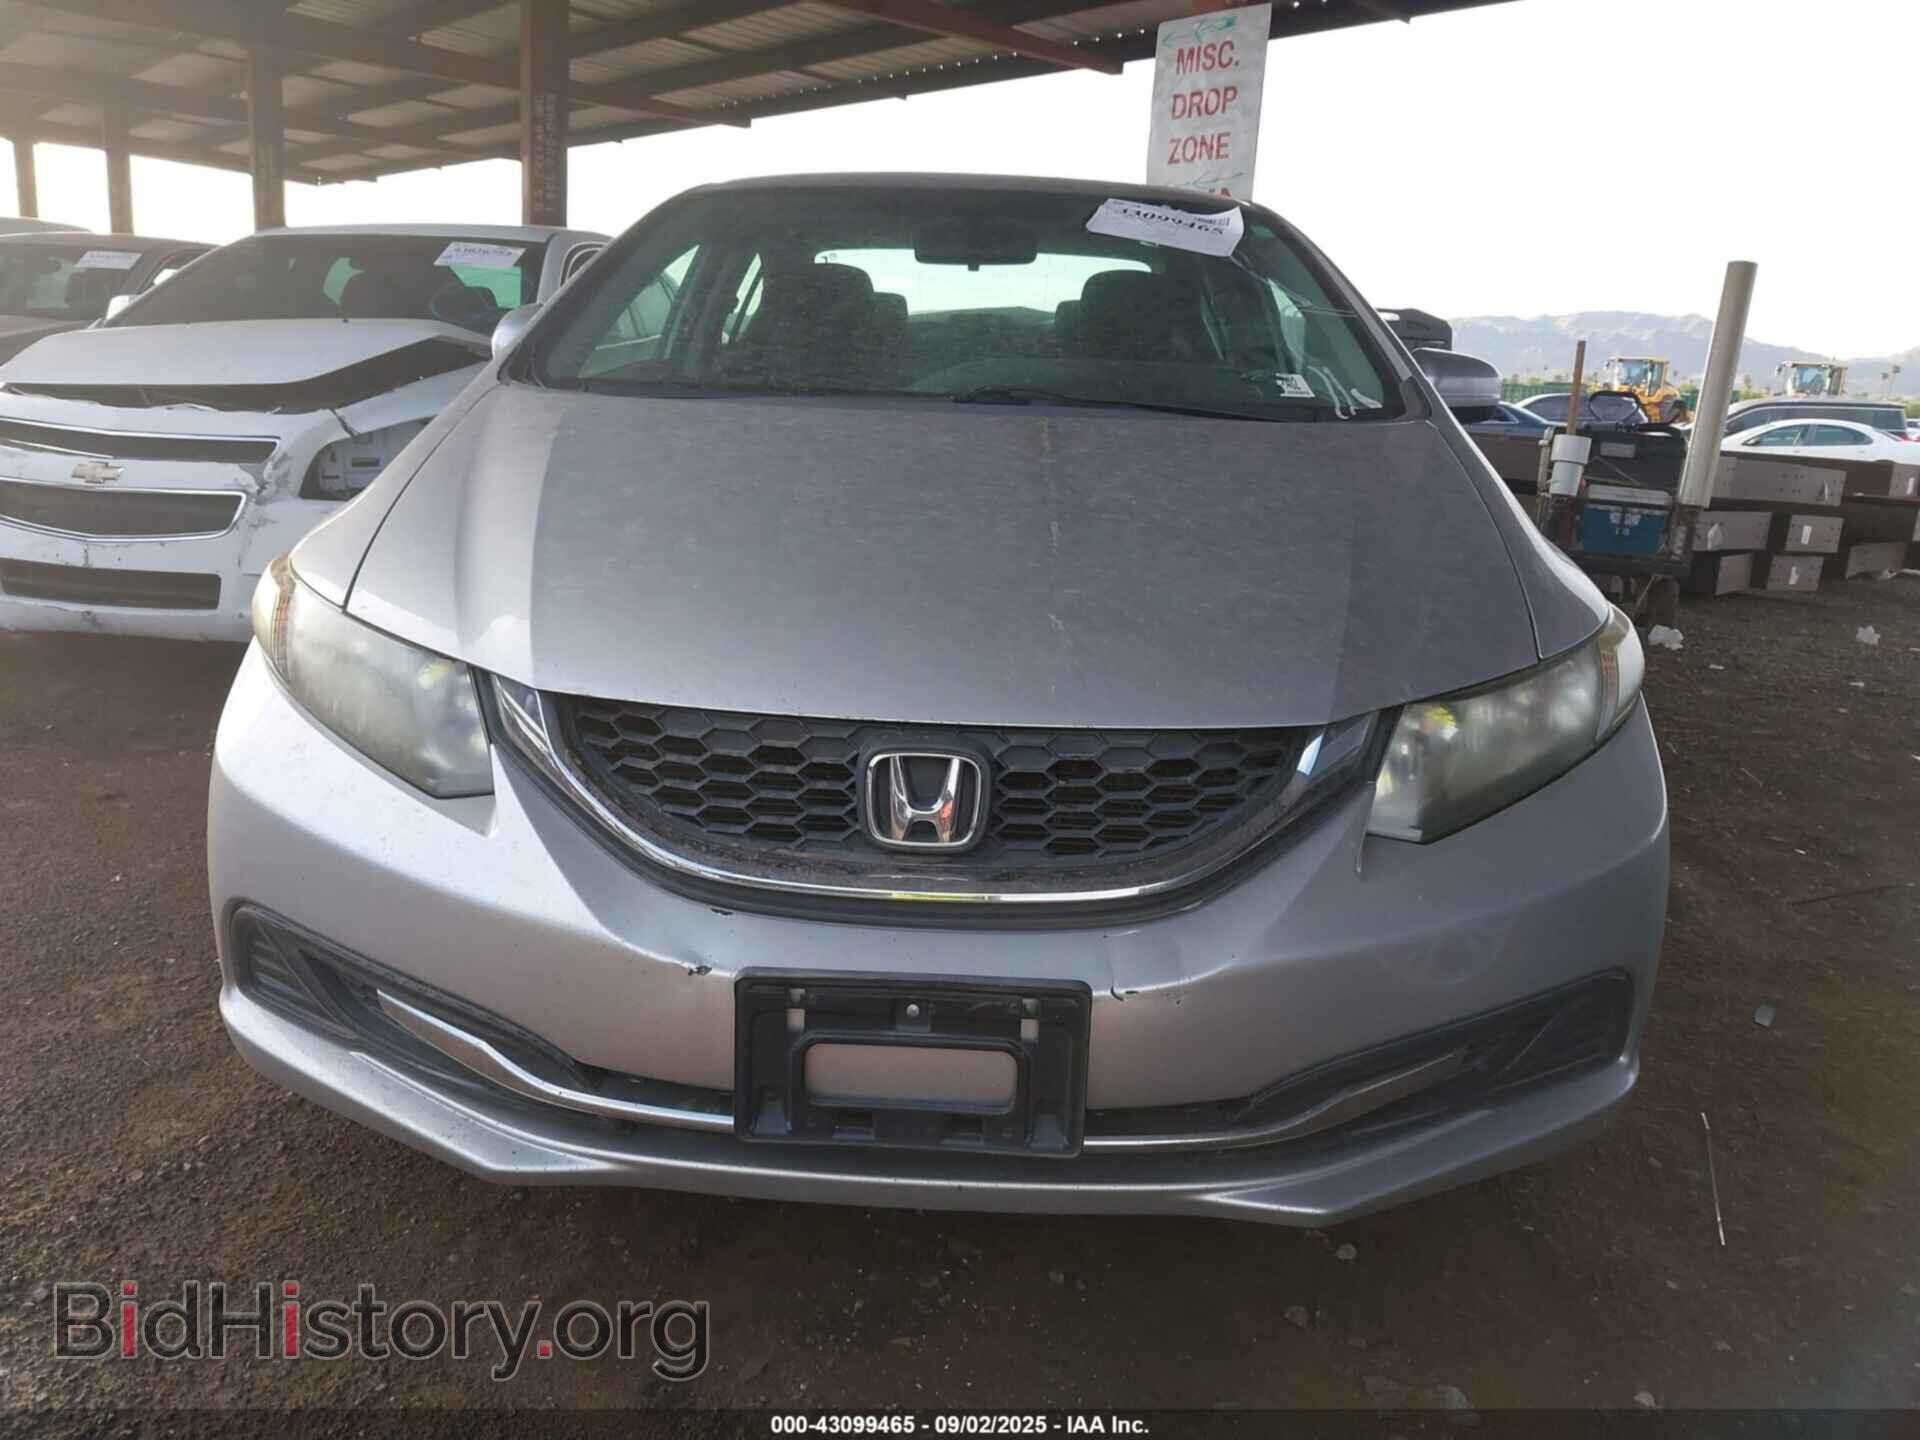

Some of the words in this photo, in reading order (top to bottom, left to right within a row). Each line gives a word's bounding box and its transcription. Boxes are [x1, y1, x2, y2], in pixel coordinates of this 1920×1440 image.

[1176, 40, 1239, 75] MISC.
[1170, 86, 1238, 120] DROP
[1167, 131, 1231, 165] ZONE
